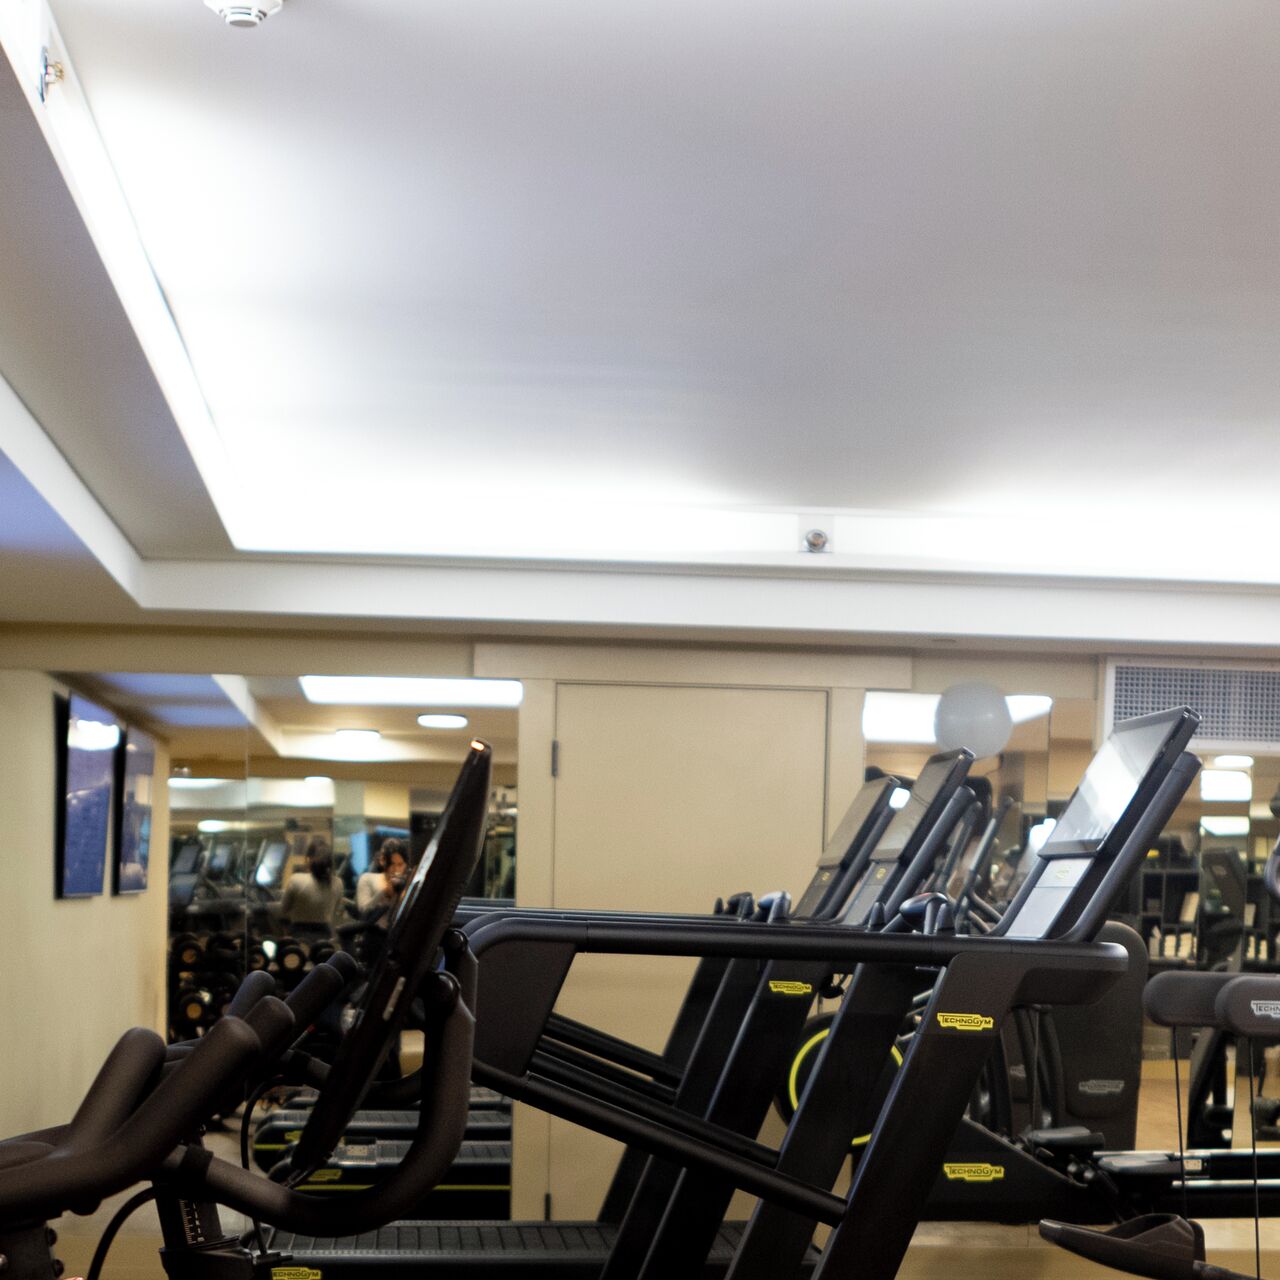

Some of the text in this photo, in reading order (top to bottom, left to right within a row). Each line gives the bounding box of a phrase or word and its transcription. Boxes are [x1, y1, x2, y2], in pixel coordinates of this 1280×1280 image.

[939, 1014, 991, 1027] TECHNOGYM
[946, 1166, 1002, 1178] TECHNOGYM
[272, 1269, 319, 1279] ECHNOGYM
